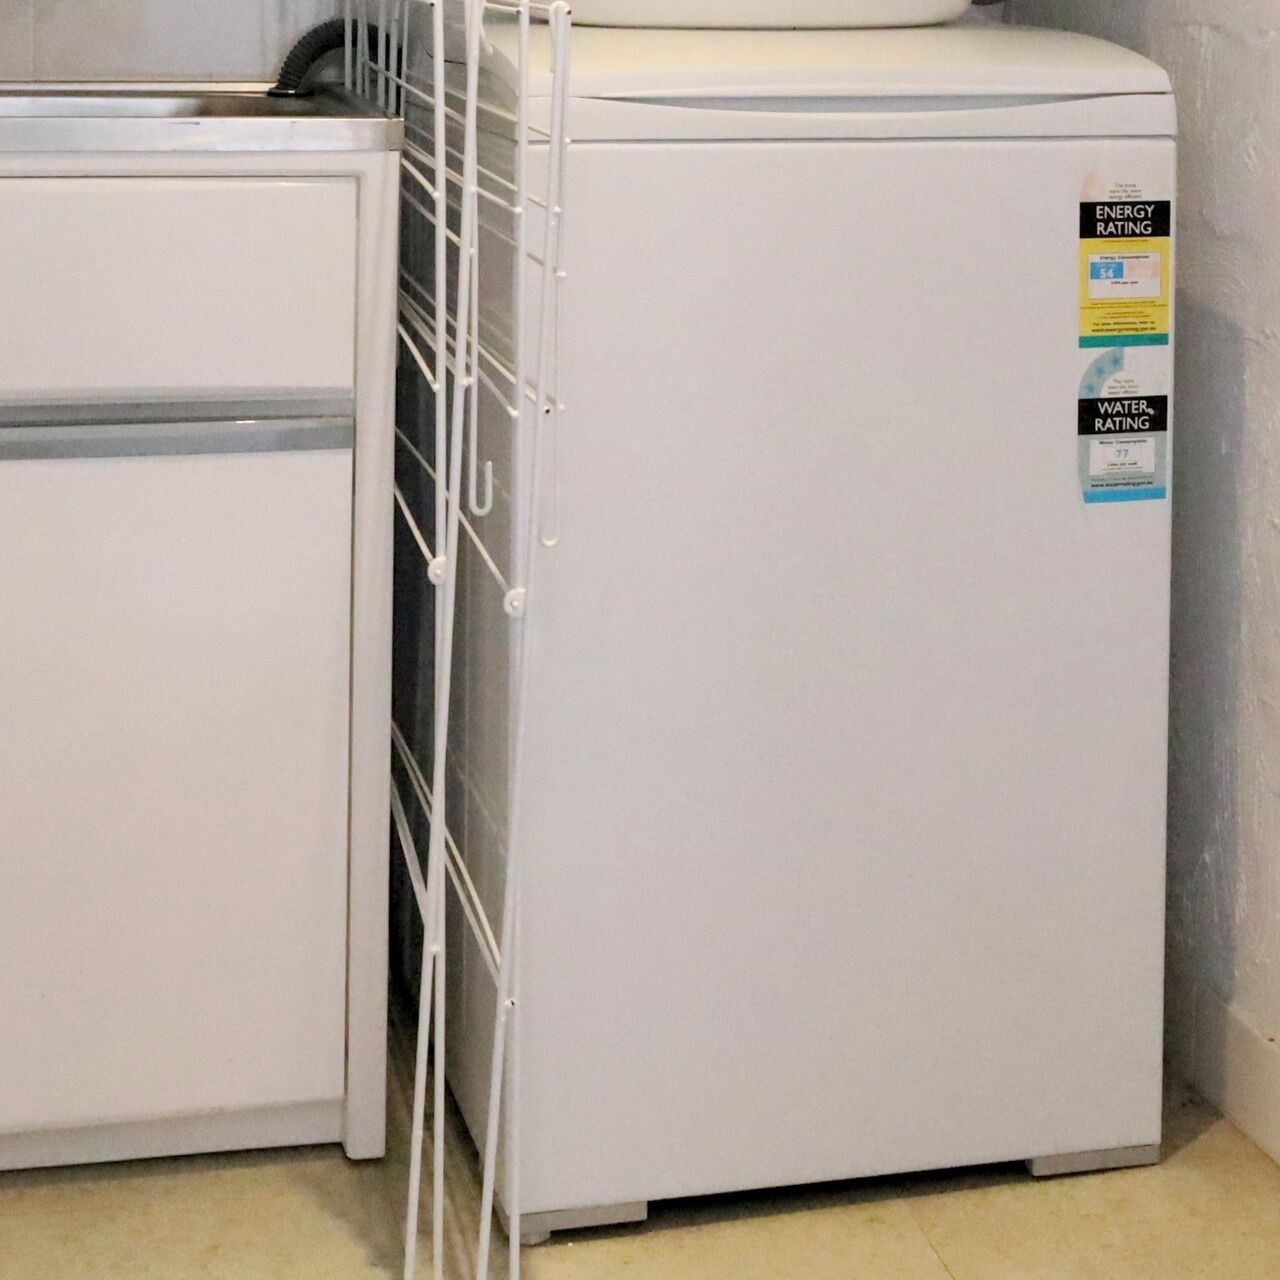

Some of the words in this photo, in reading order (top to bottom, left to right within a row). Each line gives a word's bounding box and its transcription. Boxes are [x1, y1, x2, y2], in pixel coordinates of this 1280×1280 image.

[1096, 204, 1155, 219] ENERGY
[1096, 221, 1152, 235] RATING
[1098, 400, 1148, 415] WATER
[1095, 416, 1150, 431] RATING
